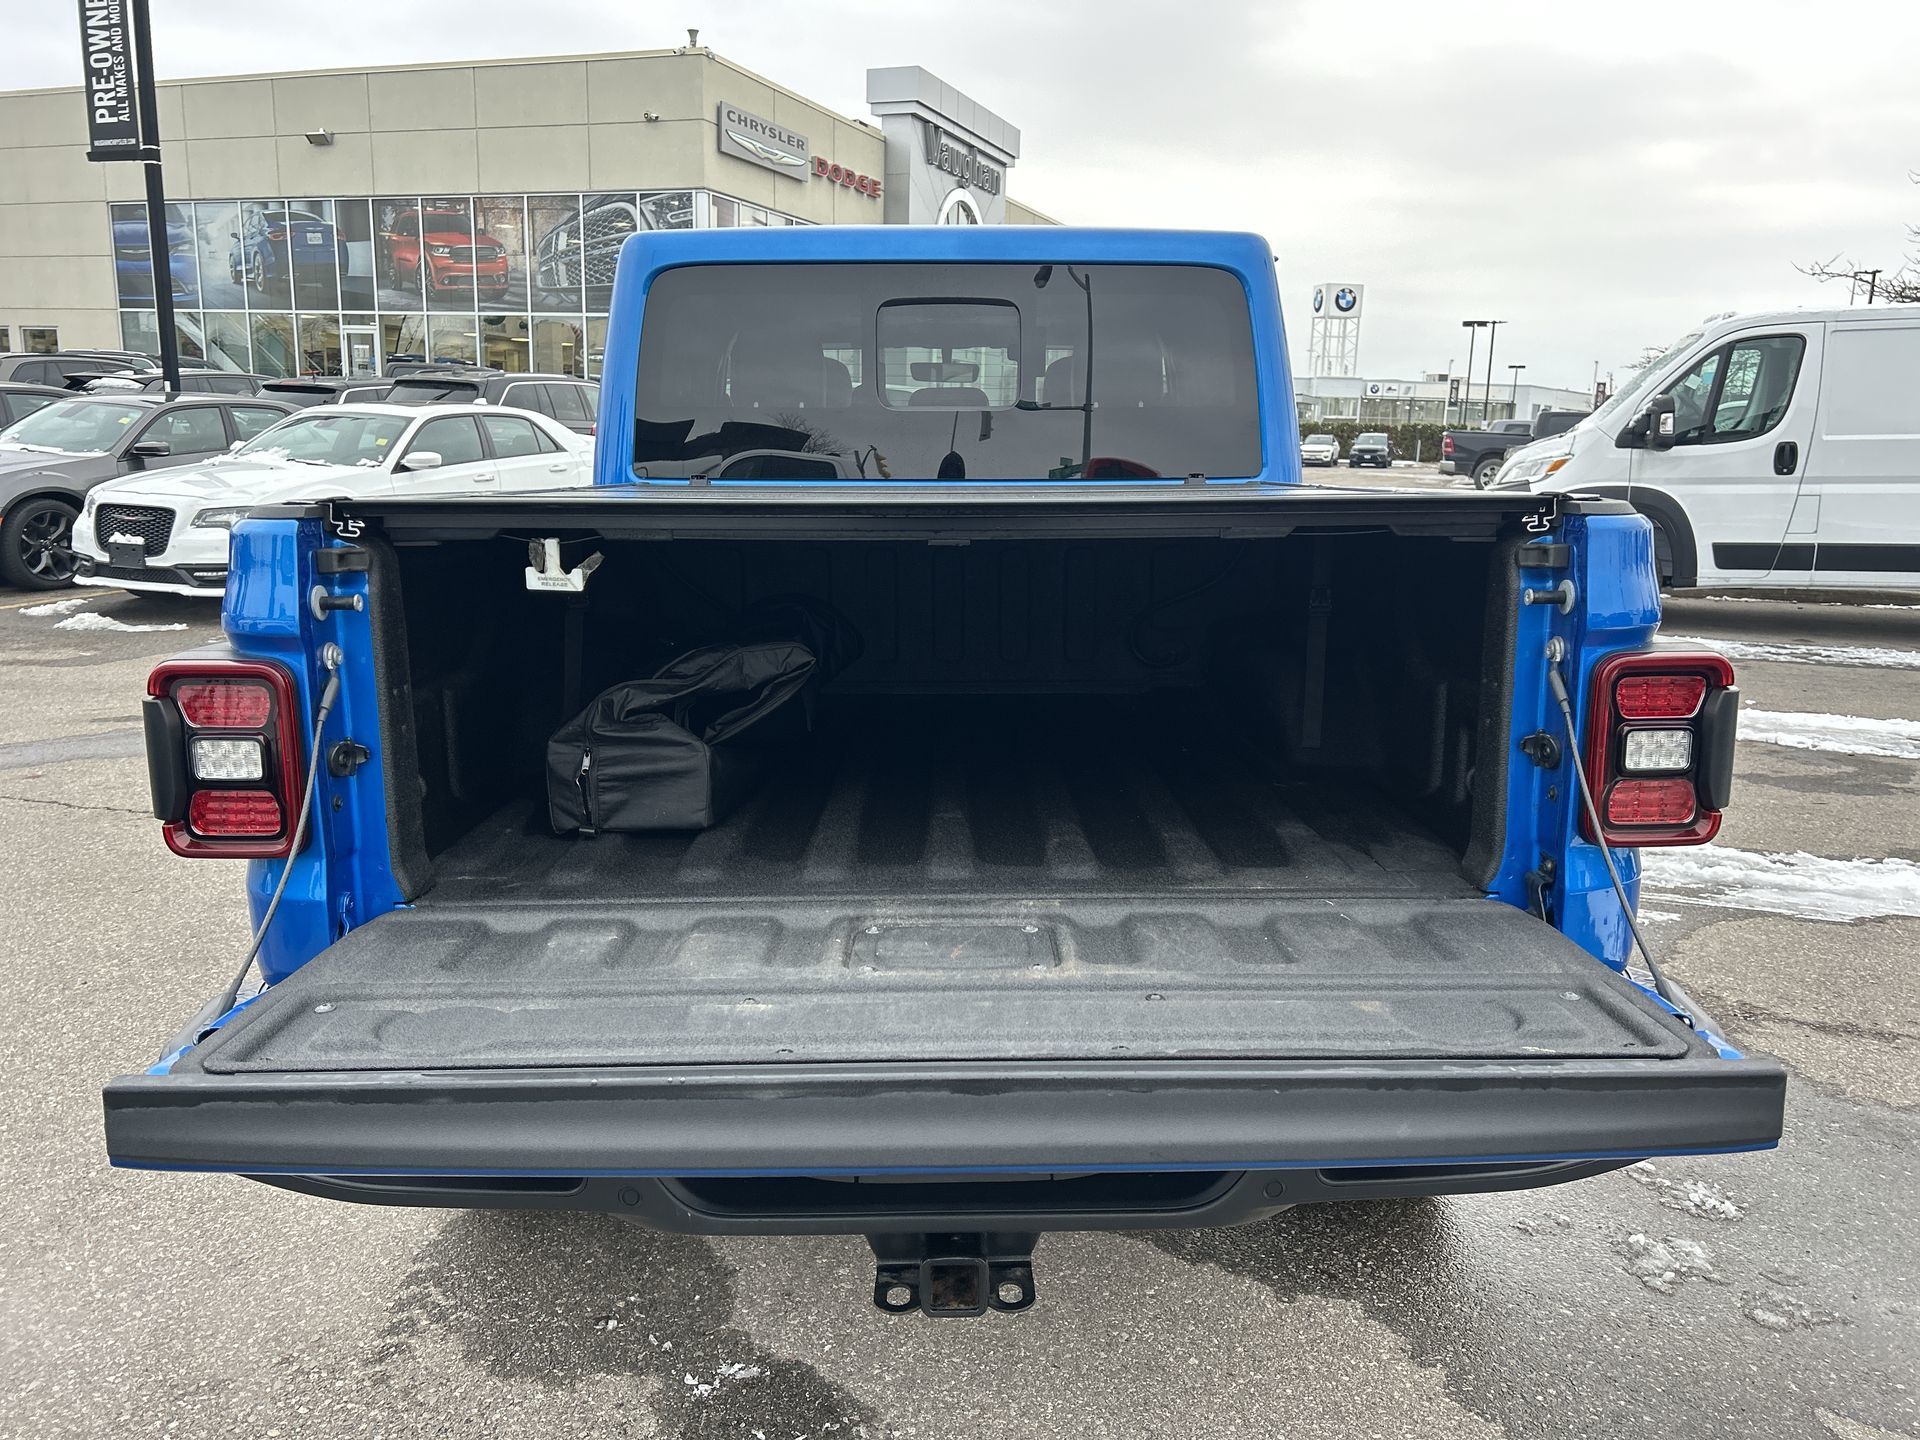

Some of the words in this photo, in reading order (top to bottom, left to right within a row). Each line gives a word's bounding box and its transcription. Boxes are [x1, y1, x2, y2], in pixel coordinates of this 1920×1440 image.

[110, 27, 124, 52] AND
[113, 55, 127, 97] MAKES
[117, 100, 130, 121] ALL
[726, 109, 806, 151] CHRYSLER
[812, 155, 882, 199] DODGE
[926, 122, 1001, 195] Vaughan
